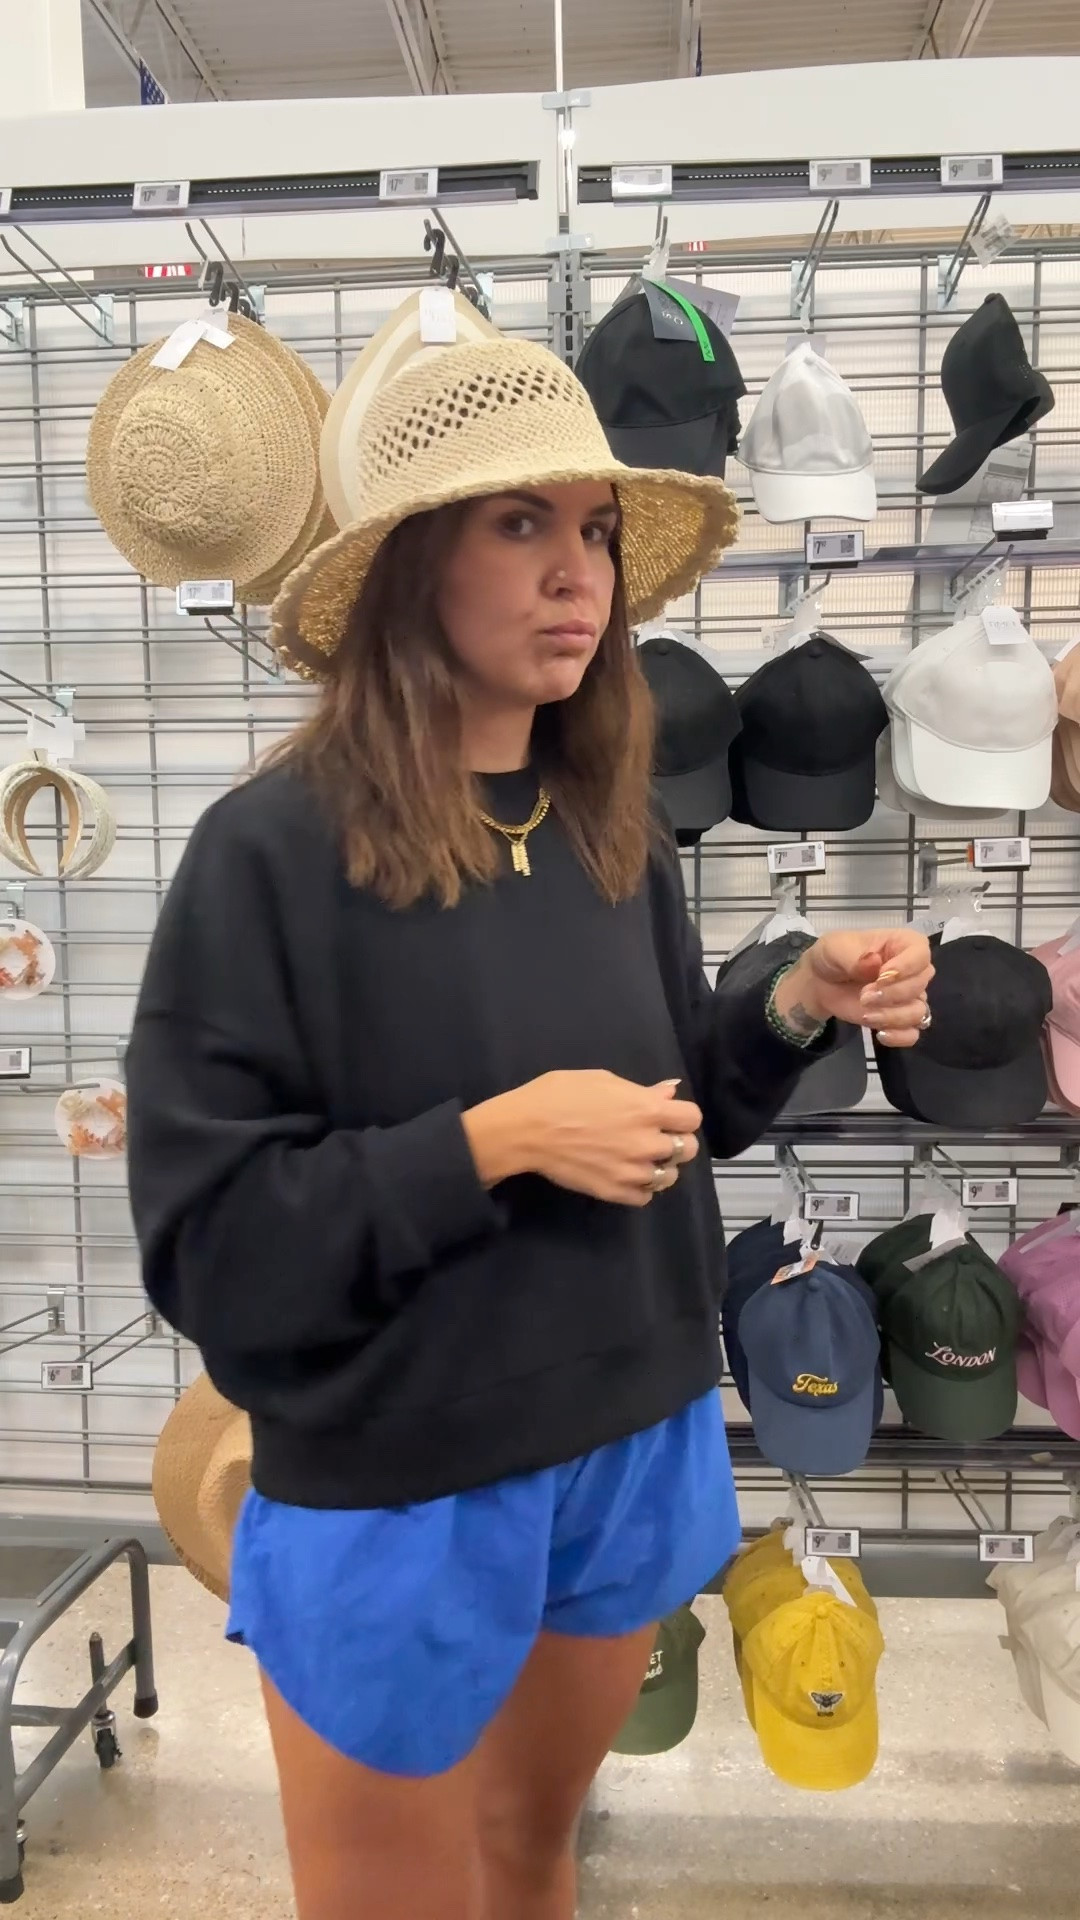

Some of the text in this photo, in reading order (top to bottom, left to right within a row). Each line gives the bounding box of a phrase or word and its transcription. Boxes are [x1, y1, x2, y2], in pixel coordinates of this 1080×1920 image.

[924, 1341, 997, 1368] LONDON
[792, 1373, 838, 1397] Texas
[649, 1649, 665, 1665] ET
